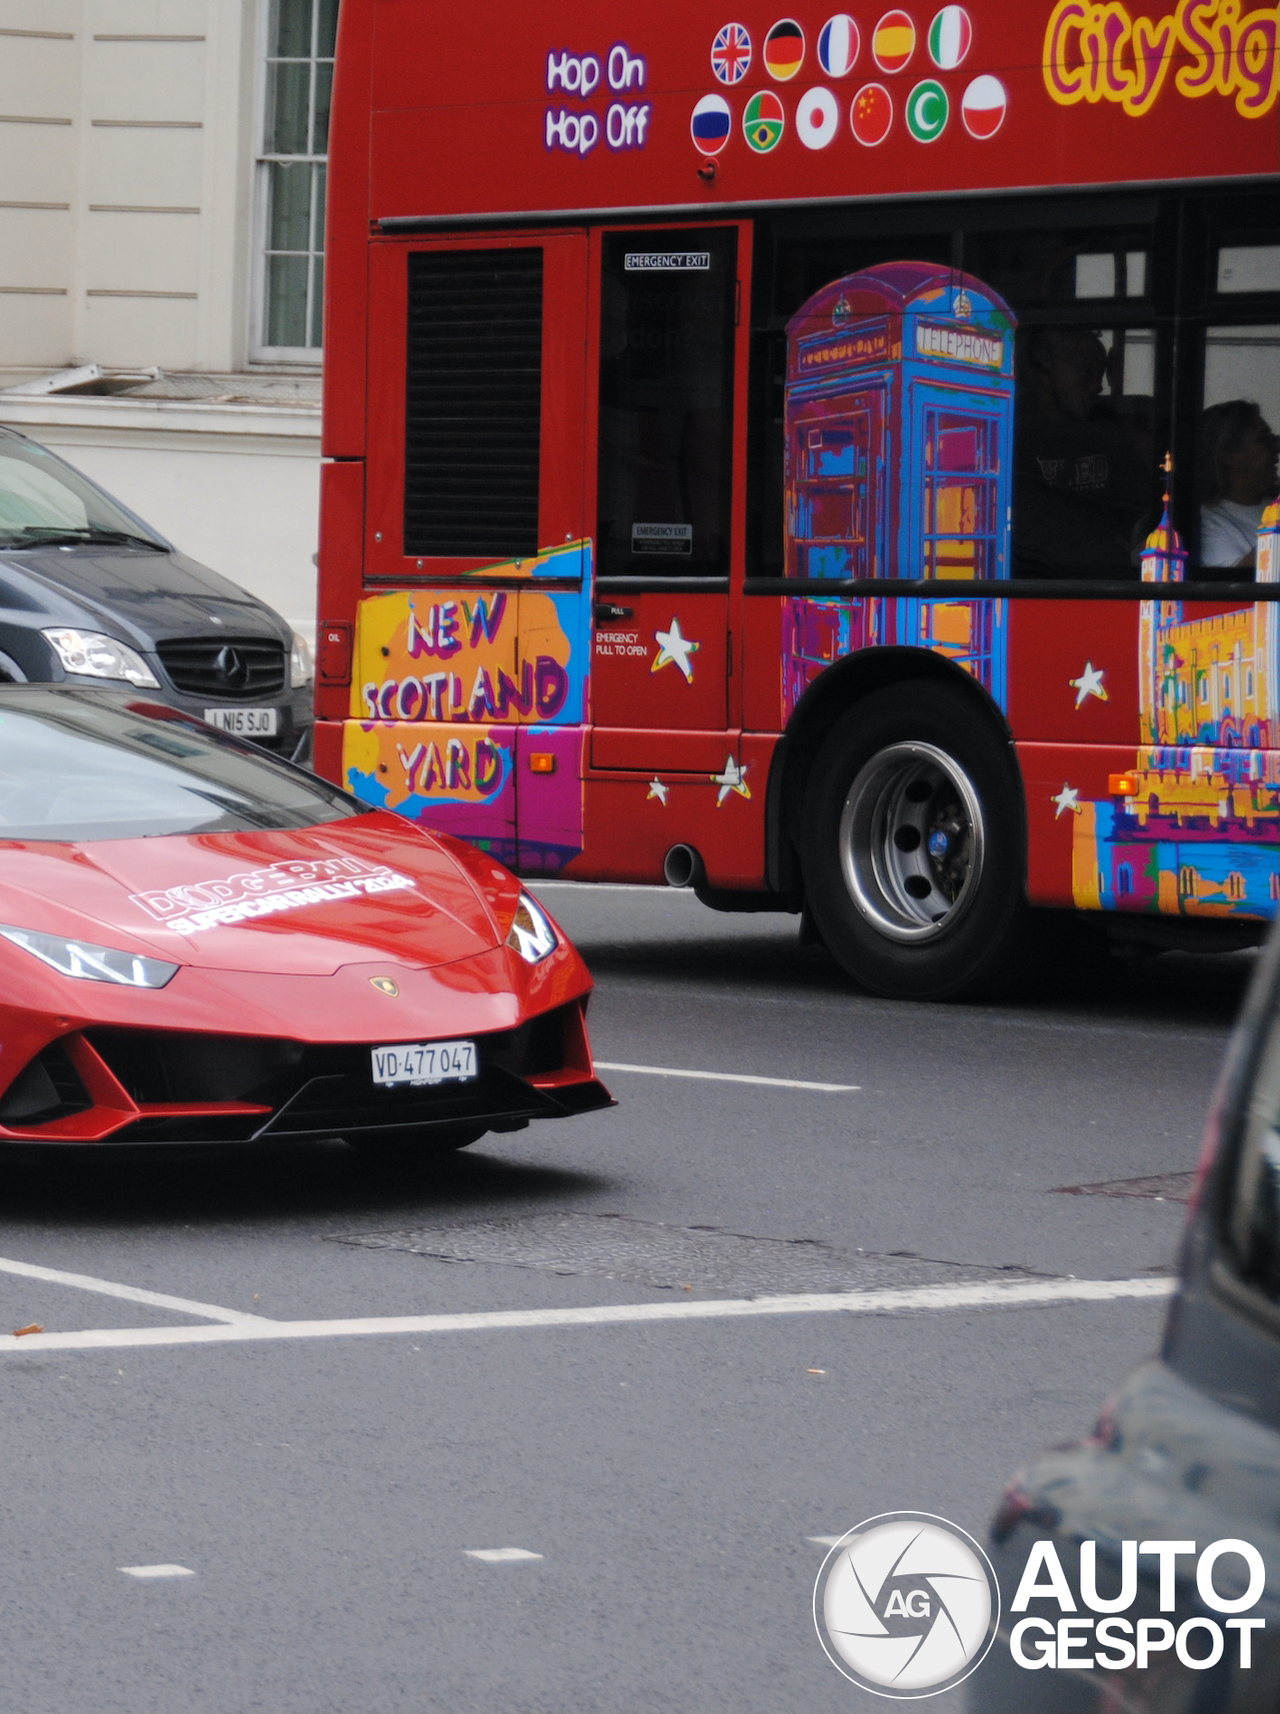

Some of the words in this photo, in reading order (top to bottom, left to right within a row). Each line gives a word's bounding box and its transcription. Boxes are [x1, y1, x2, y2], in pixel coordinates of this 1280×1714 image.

[547, 51, 600, 97] Hop
[607, 44, 644, 90] On
[545, 109, 598, 155] Hop
[606, 103, 650, 148] Off
[626, 255, 683, 267] EMERGENCY
[685, 254, 707, 267] EXIT
[920, 325, 1000, 363] TELEPHONE
[636, 526, 674, 536] EMERGENCY
[674, 526, 688, 537] EXIT
[610, 607, 625, 615] PULL
[328, 633, 340, 642] OIL
[407, 592, 507, 660] NEW
[596, 632, 639, 643] EMERGENCY
[595, 645, 613, 655] PULL
[615, 645, 626, 656] TO
[626, 646, 648, 656] OPEN
[362, 655, 570, 732] SCOTLAND
[396, 737, 504, 797] YARD
